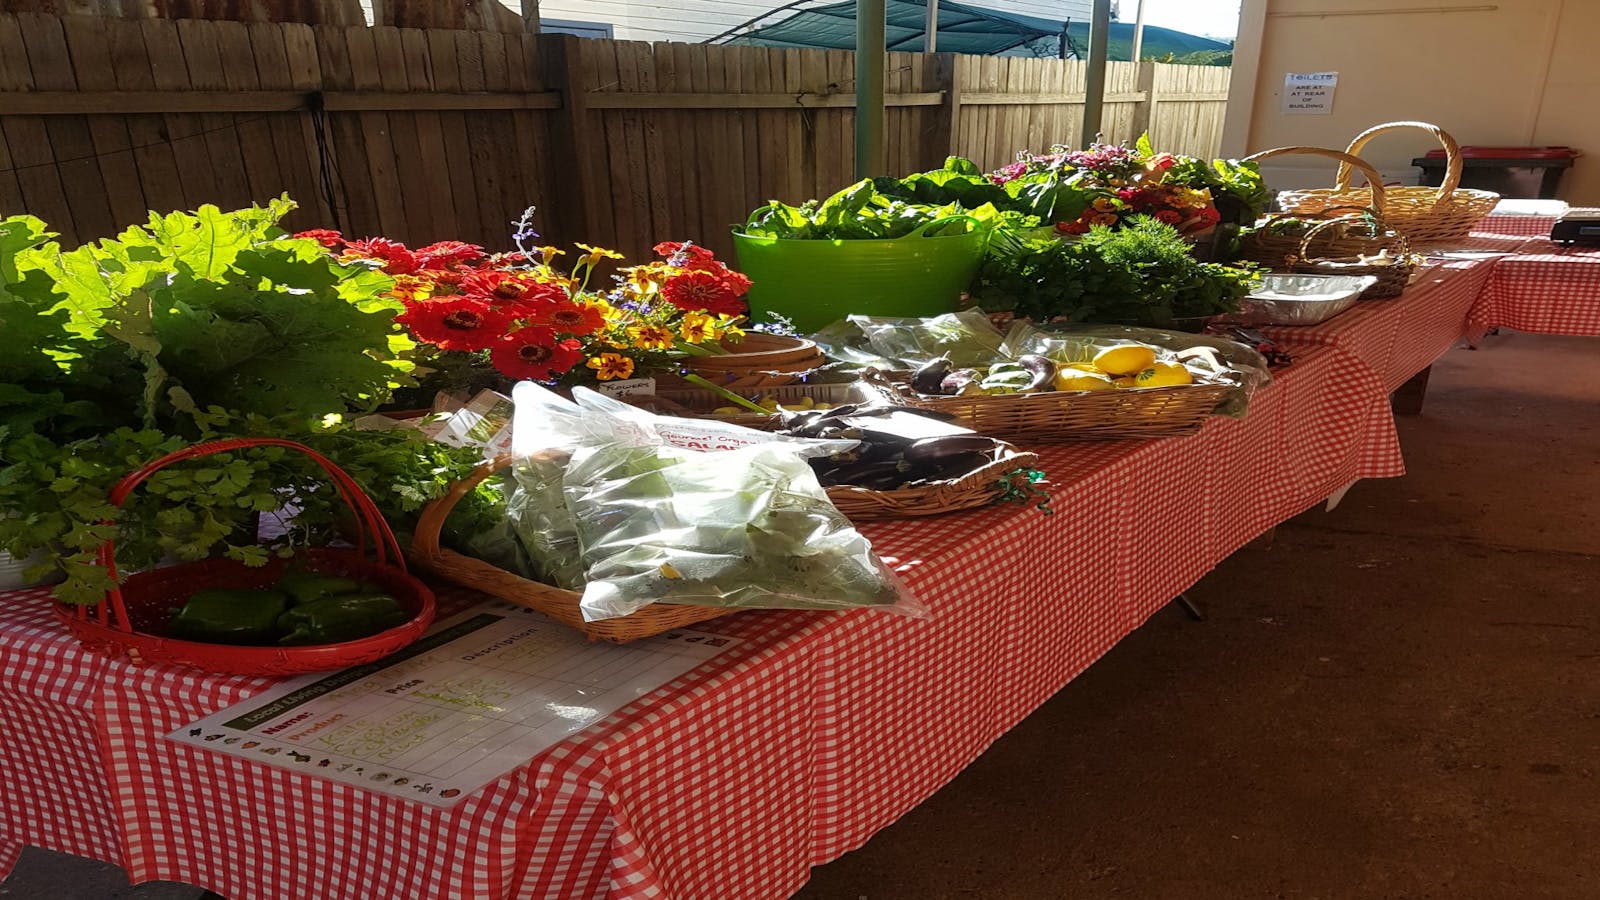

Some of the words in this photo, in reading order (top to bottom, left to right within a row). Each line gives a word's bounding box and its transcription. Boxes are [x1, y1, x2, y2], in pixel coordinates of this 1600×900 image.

[288, 712, 348, 741] Product
[384, 678, 425, 695] Price
[462, 627, 540, 661] Description
[244, 703, 284, 724] Local
[285, 685, 328, 706] Living
[261, 711, 314, 735] Name:
